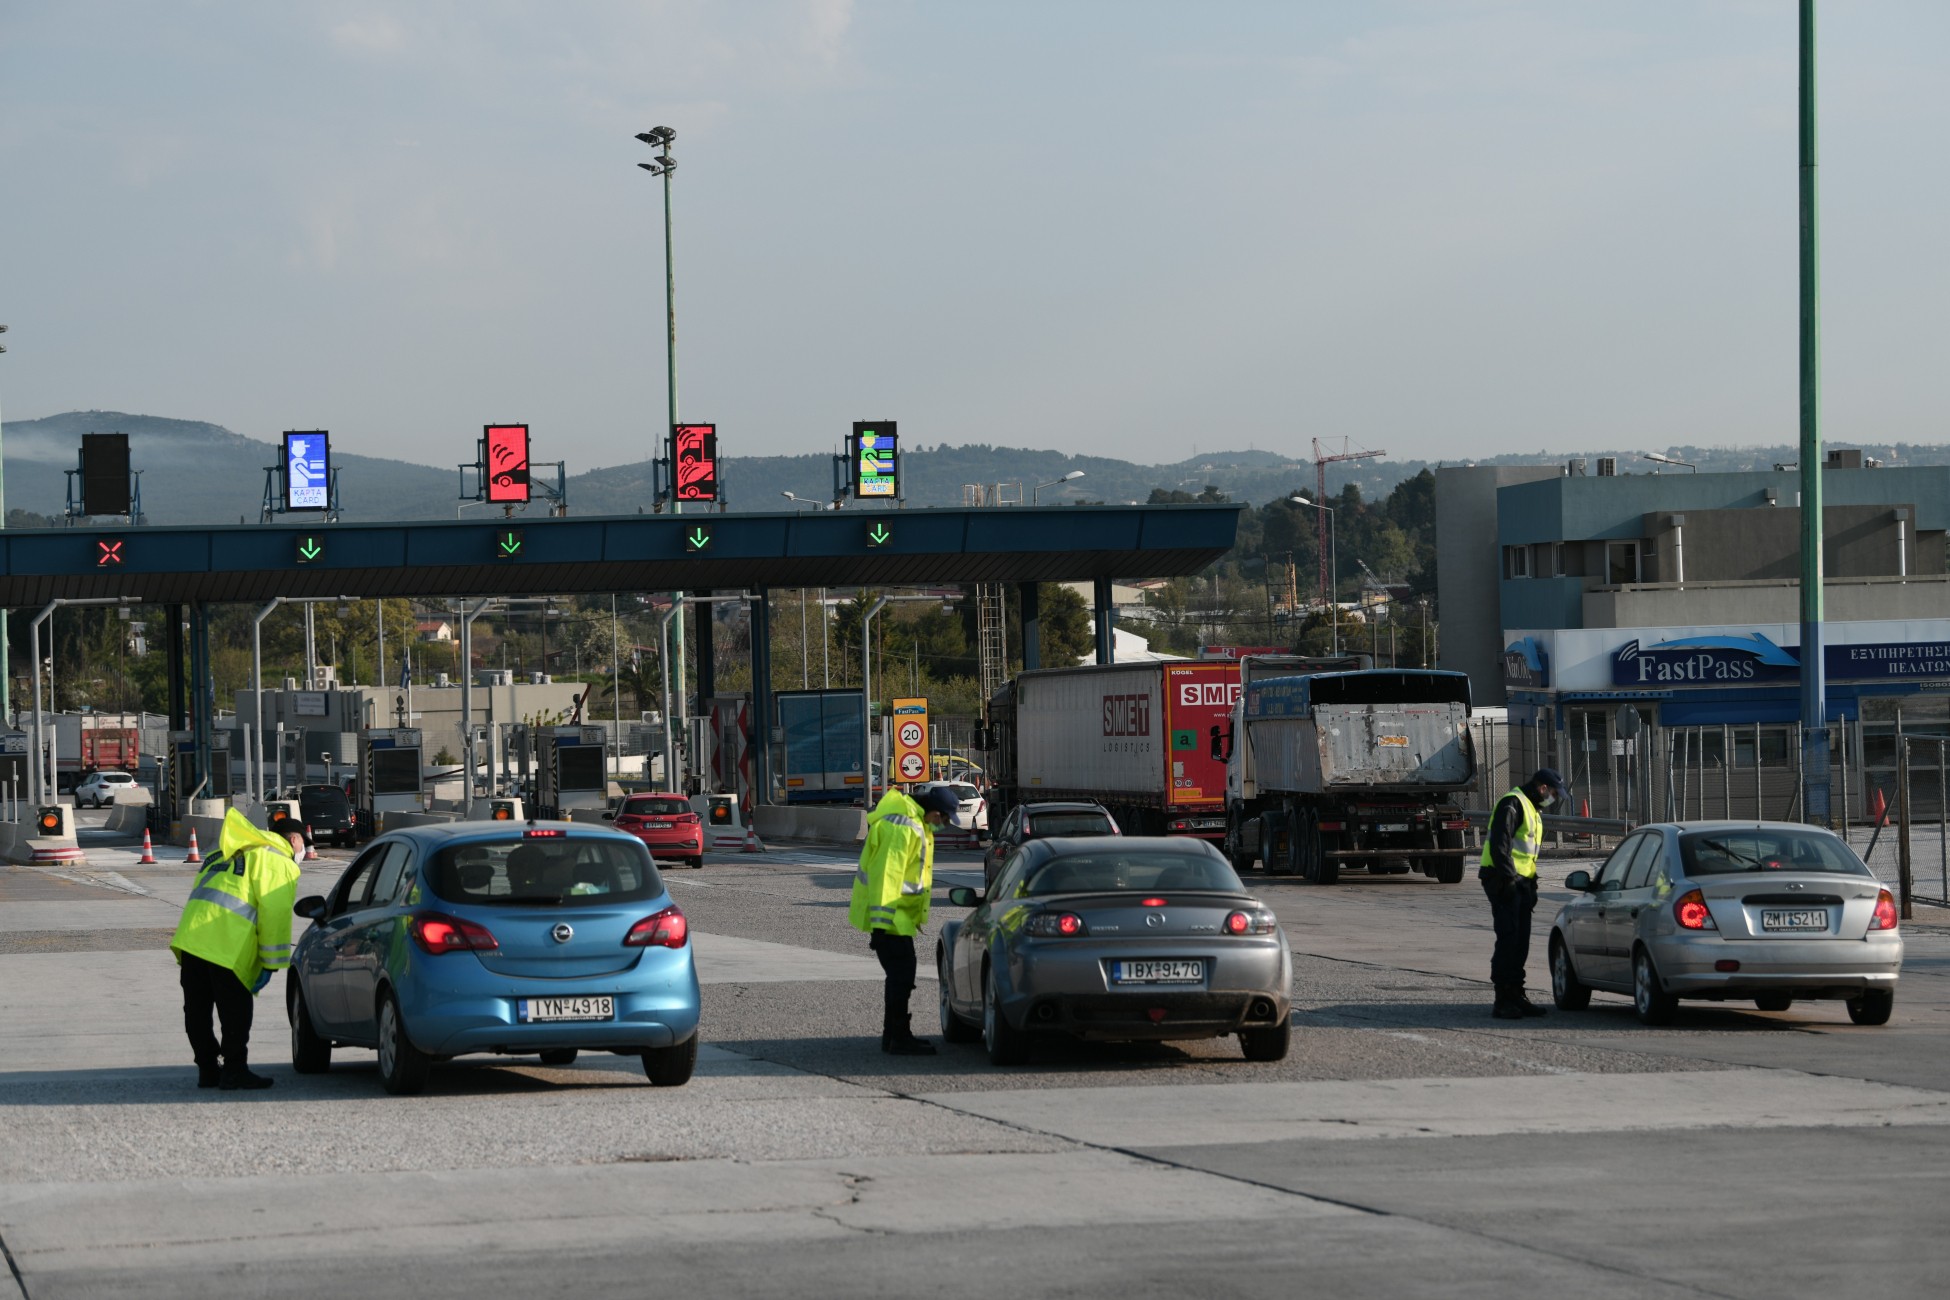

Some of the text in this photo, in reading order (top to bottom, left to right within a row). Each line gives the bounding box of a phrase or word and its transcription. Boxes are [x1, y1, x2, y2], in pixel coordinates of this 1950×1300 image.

[1637, 654, 1755, 682] FastPass
[1104, 699, 1148, 733] SMET
[903, 729, 919, 741] 20
[1103, 742, 1151, 753] LOGISTICS
